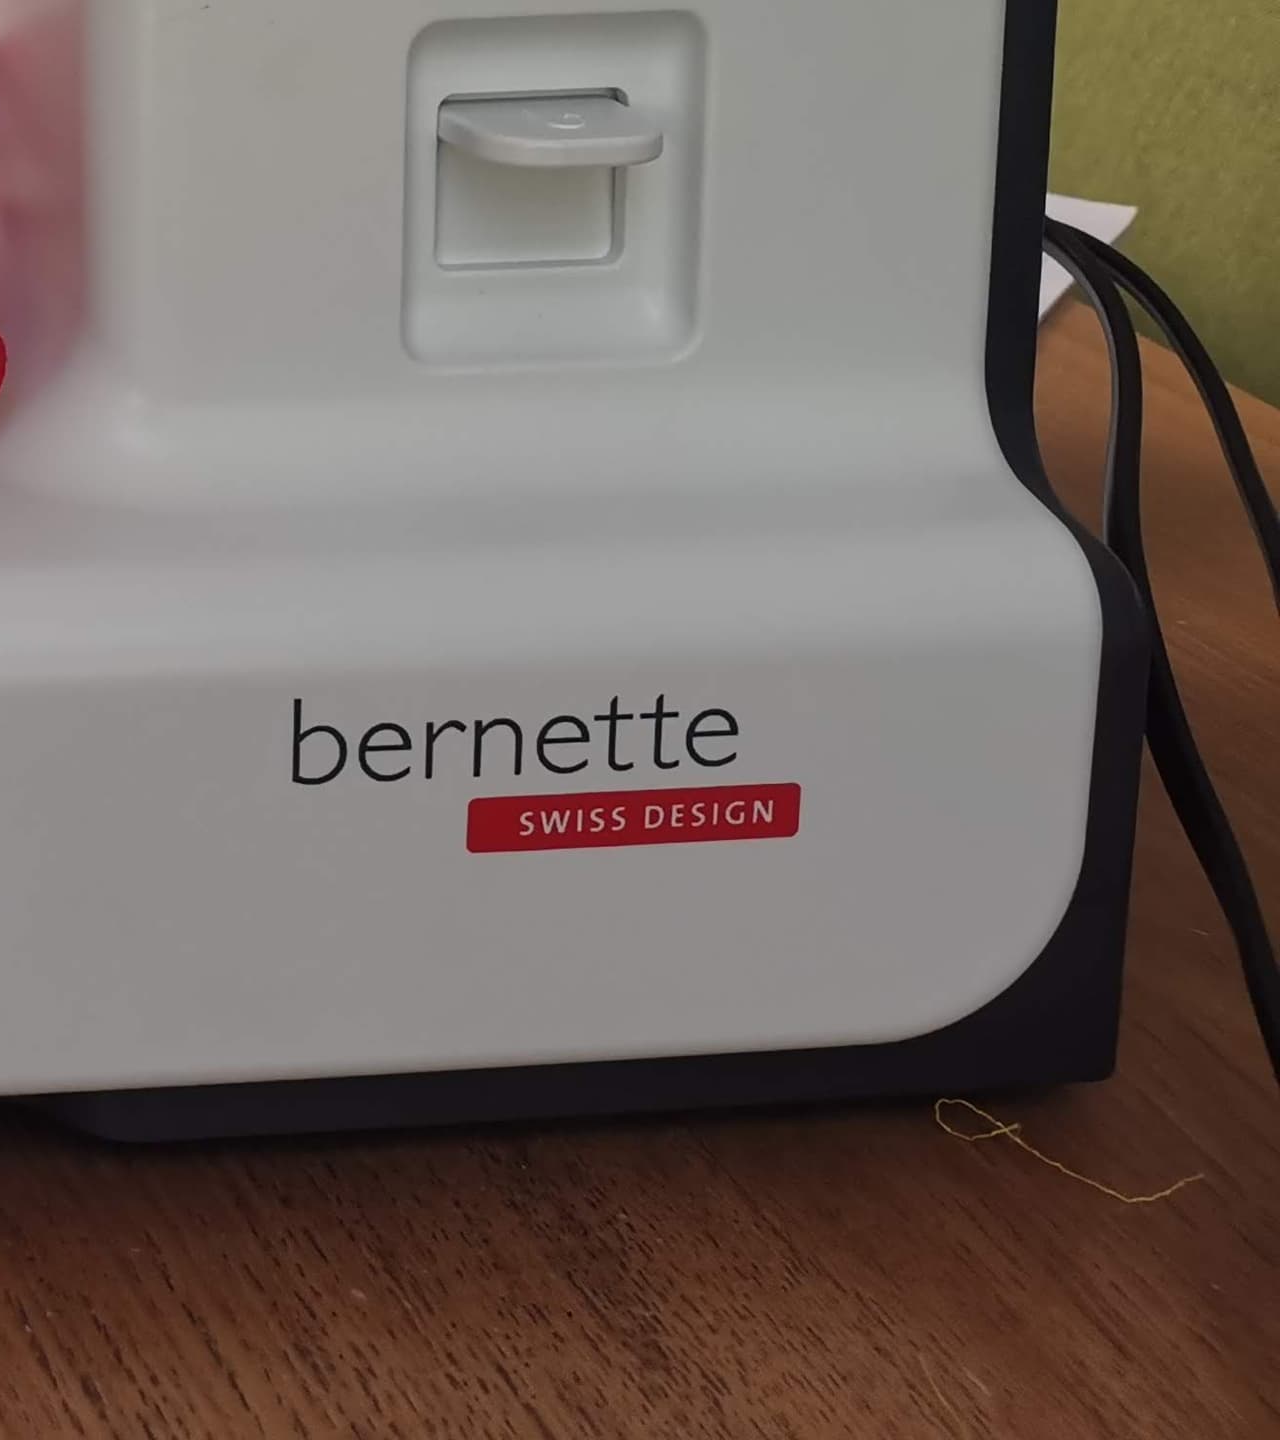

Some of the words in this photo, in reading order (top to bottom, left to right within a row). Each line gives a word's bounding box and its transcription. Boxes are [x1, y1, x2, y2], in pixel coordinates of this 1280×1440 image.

[292, 693, 739, 785] bernette
[519, 806, 627, 836] SWISS
[644, 799, 775, 830] DESIGN
